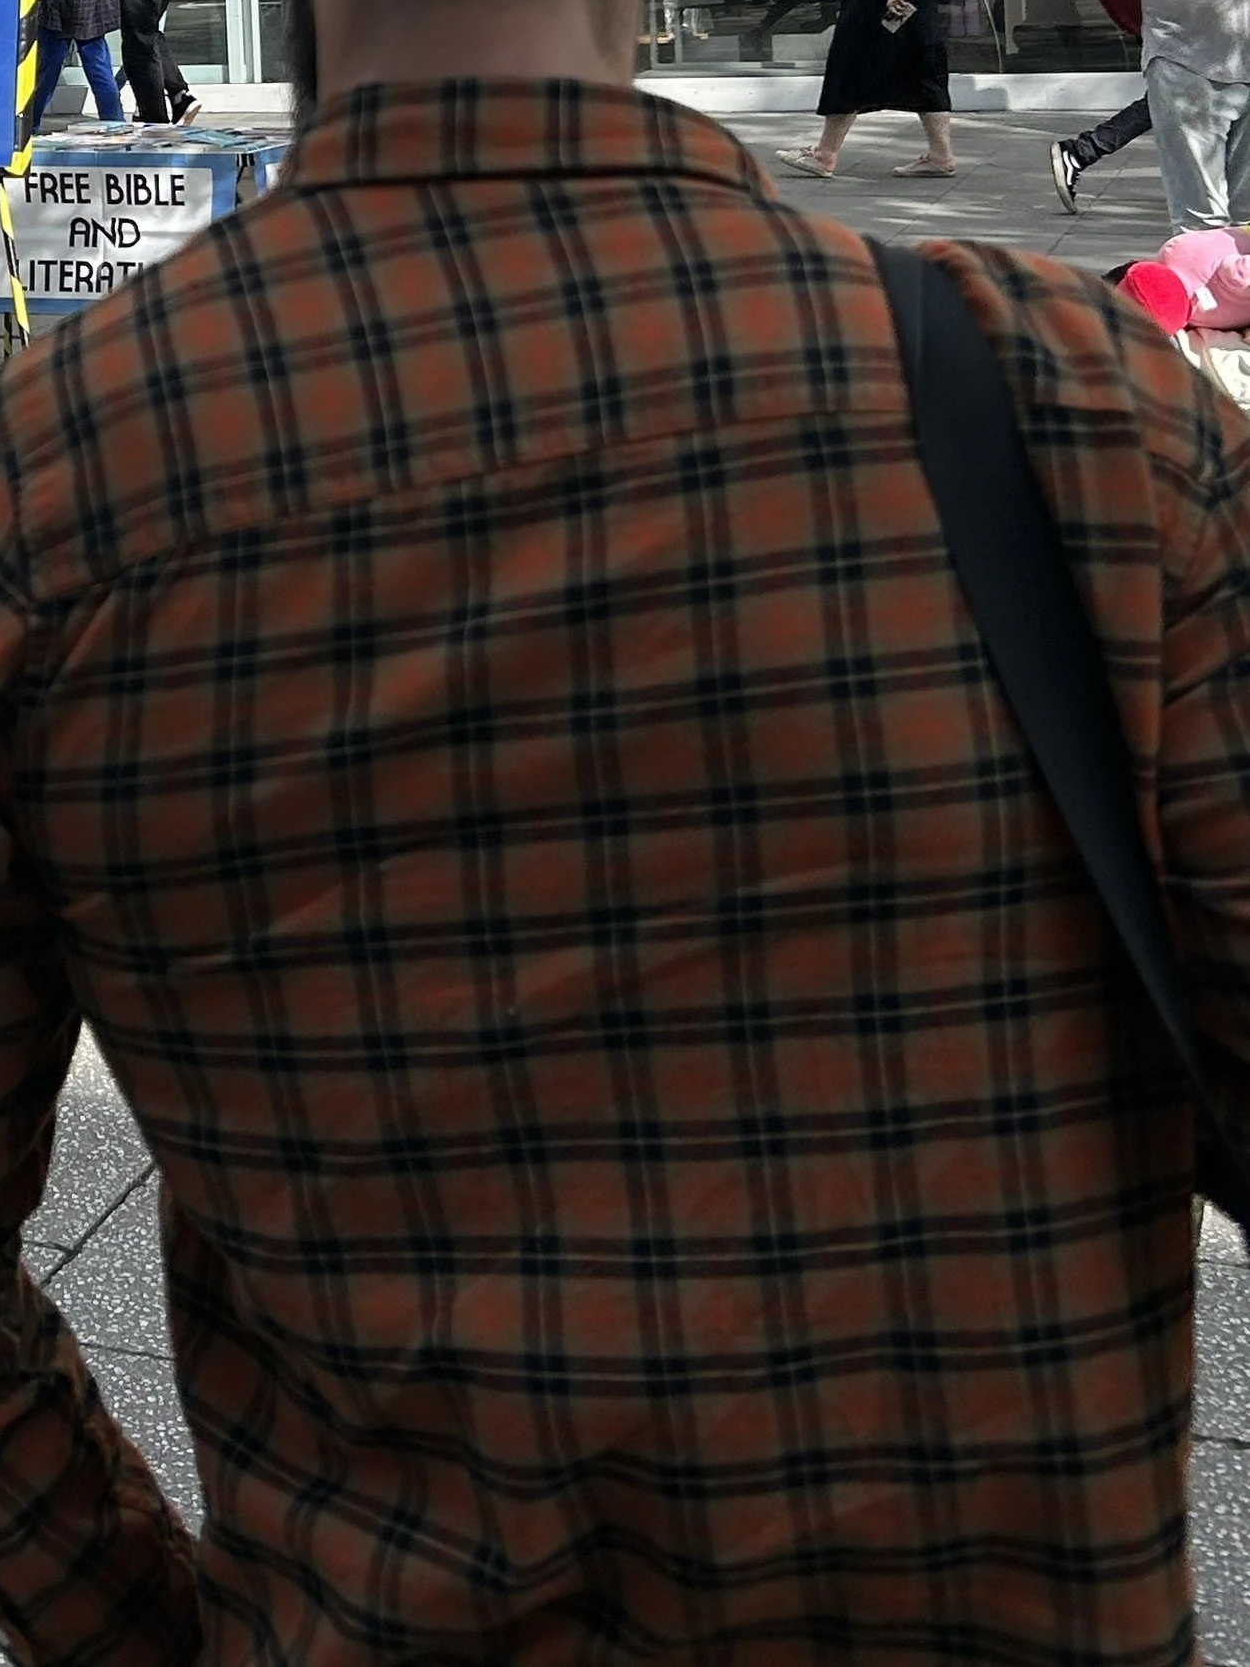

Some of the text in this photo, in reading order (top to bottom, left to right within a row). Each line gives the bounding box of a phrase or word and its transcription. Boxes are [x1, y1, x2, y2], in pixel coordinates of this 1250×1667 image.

[24, 172, 186, 207] FREE BIBLE
[68, 216, 142, 249] AND
